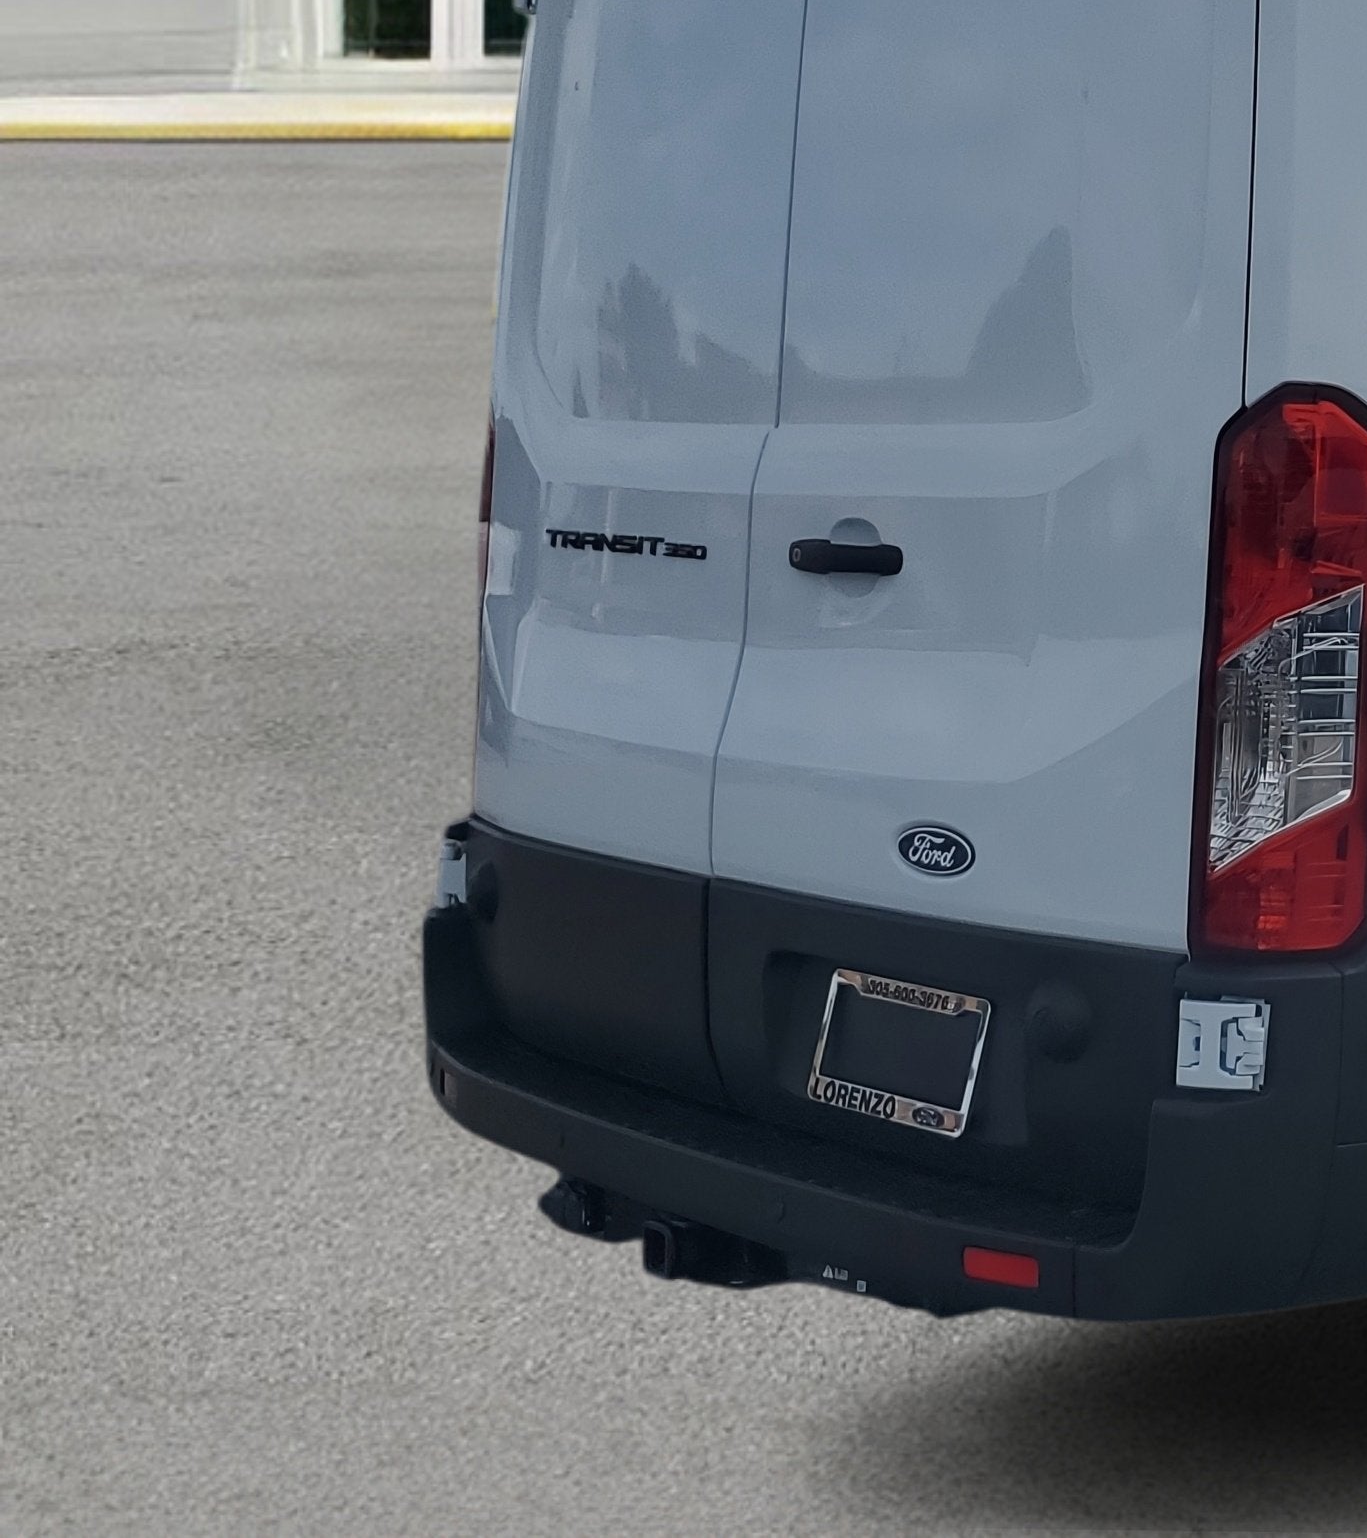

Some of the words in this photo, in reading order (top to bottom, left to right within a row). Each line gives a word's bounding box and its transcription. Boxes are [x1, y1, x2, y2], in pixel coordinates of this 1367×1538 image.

[546, 529, 665, 556] TRANSIT
[908, 833, 956, 867] Ford
[813, 1077, 896, 1119] LORENZO
